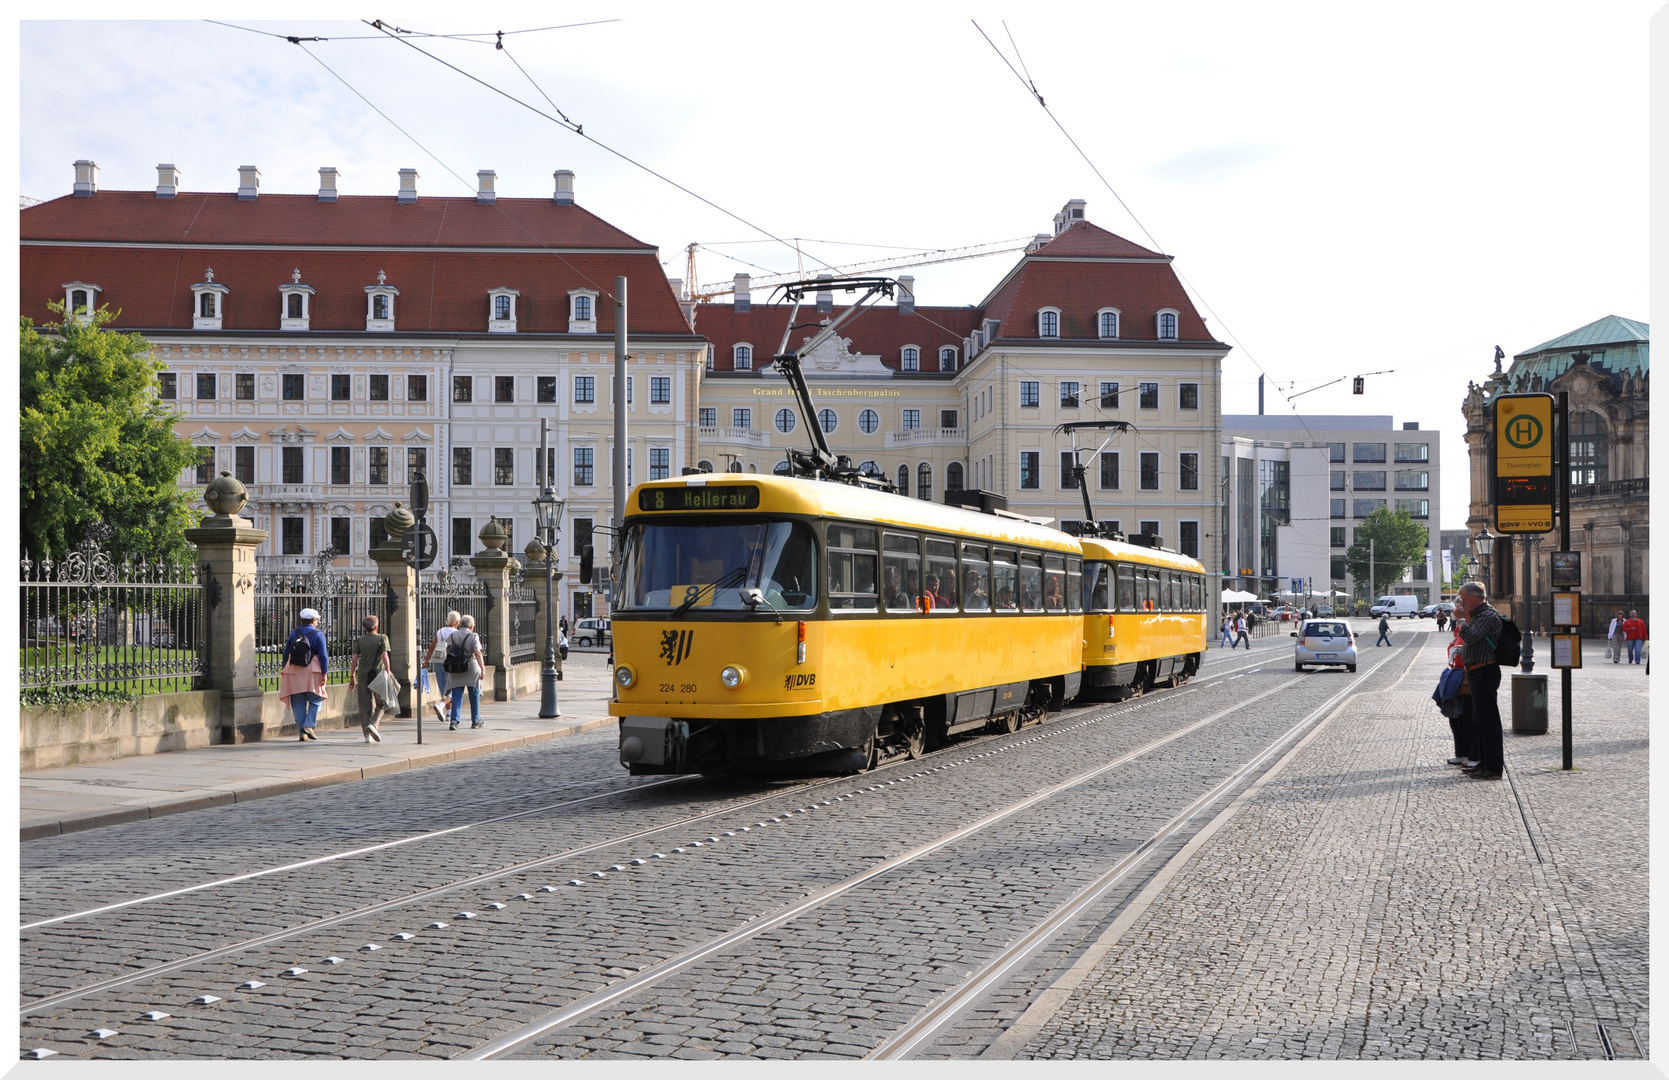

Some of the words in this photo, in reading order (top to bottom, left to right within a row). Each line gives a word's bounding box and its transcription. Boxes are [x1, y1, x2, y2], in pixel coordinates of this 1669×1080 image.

[753, 387, 783, 396] Grand
[816, 388, 901, 398] Taschenbergpalais
[1516, 422, 1532, 441] H
[655, 491, 665, 509] 8
[684, 490, 746, 507] Hellerau
[796, 674, 816, 686] DVB
[659, 683, 675, 693] 224
[680, 683, 697, 693] 280
